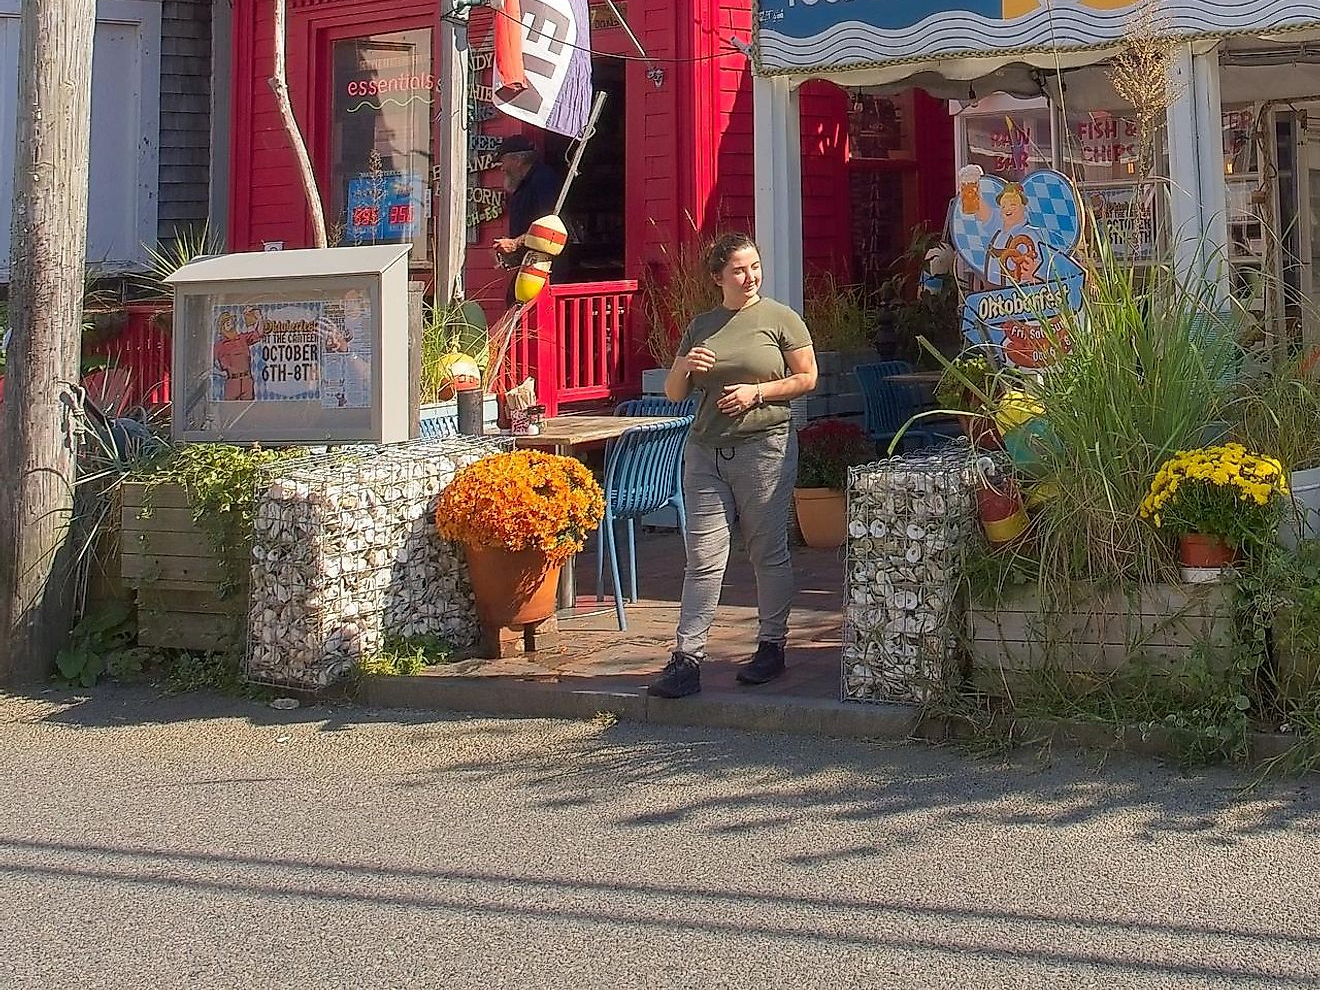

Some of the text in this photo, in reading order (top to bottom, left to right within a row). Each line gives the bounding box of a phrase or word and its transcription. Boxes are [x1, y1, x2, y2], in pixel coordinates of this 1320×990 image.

[347, 72, 435, 97] essentials
[1078, 116, 1137, 140] FISH &
[979, 283, 1069, 320] Oktoberfest
[273, 334, 286, 344] THE
[287, 332, 319, 344] CANTEEN
[262, 344, 318, 362] OCTOBER
[261, 363, 320, 382] 6TH-8TH
